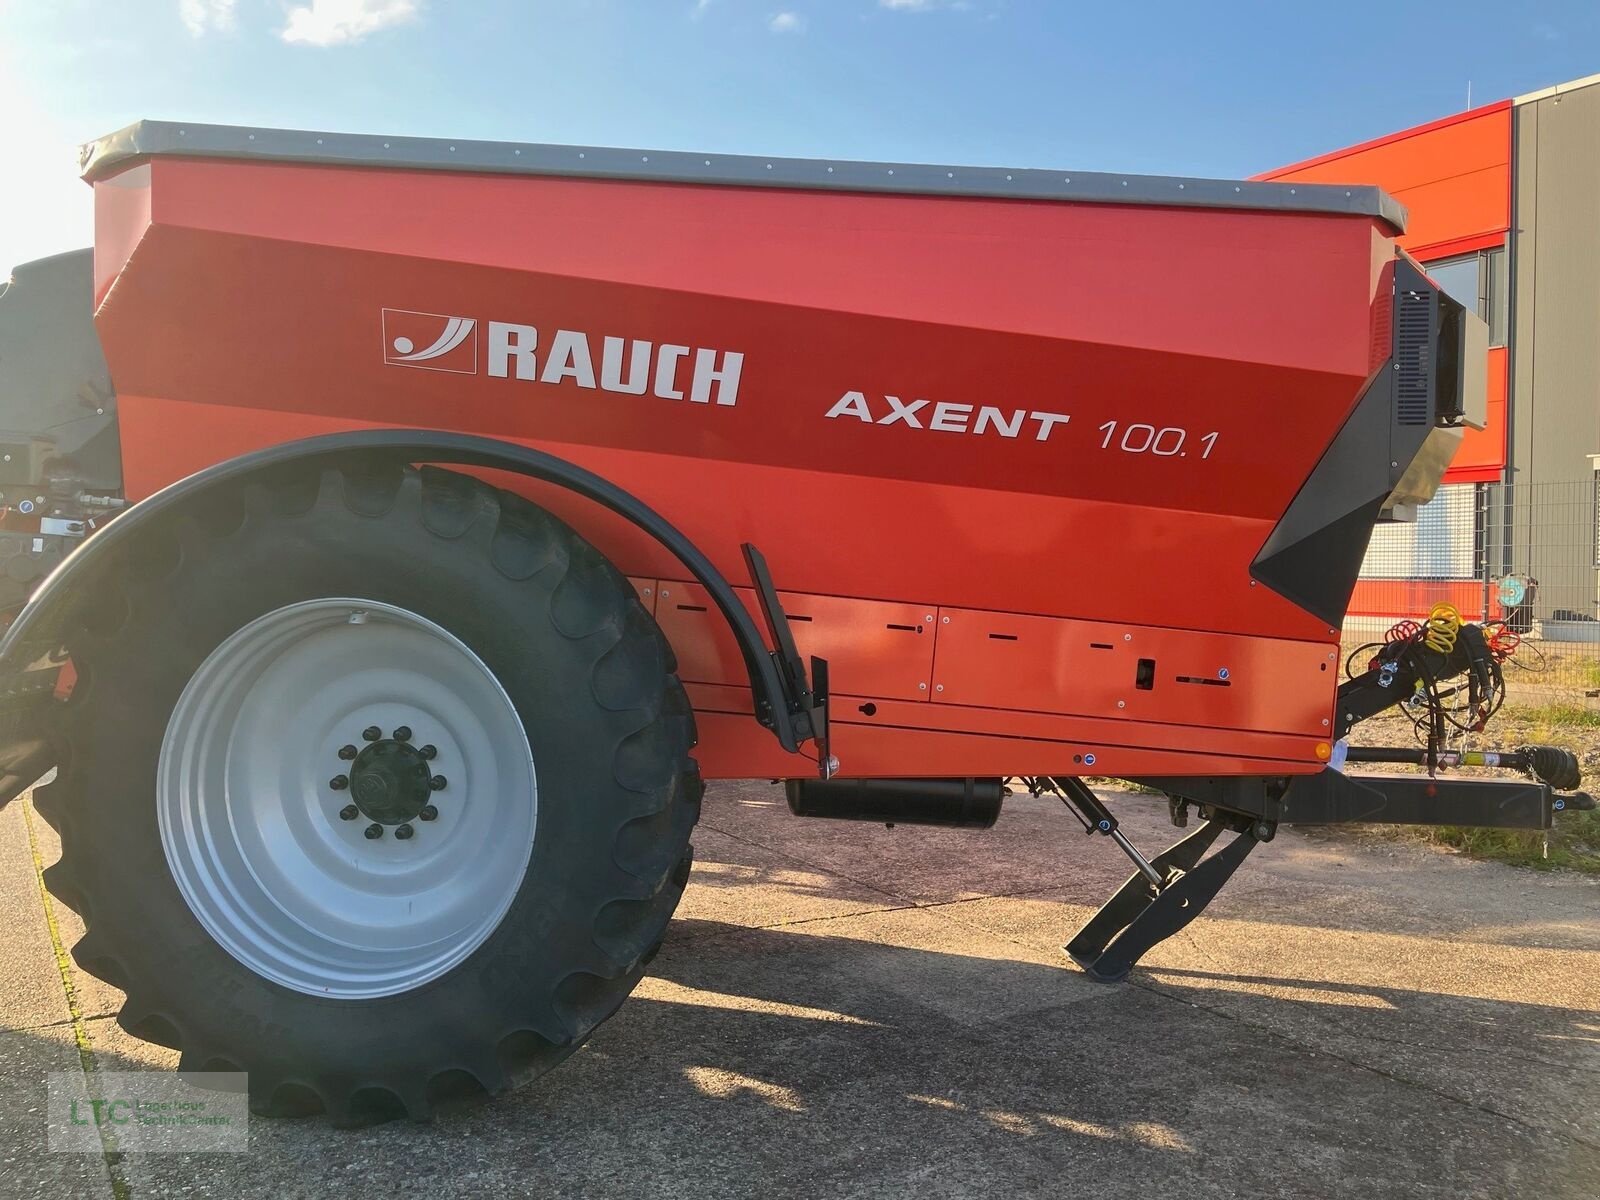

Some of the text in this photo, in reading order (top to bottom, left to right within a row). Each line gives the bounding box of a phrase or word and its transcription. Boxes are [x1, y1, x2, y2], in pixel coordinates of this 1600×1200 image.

[488, 321, 744, 405] RAUCH
[825, 390, 1219, 459] AXENT 100.1
